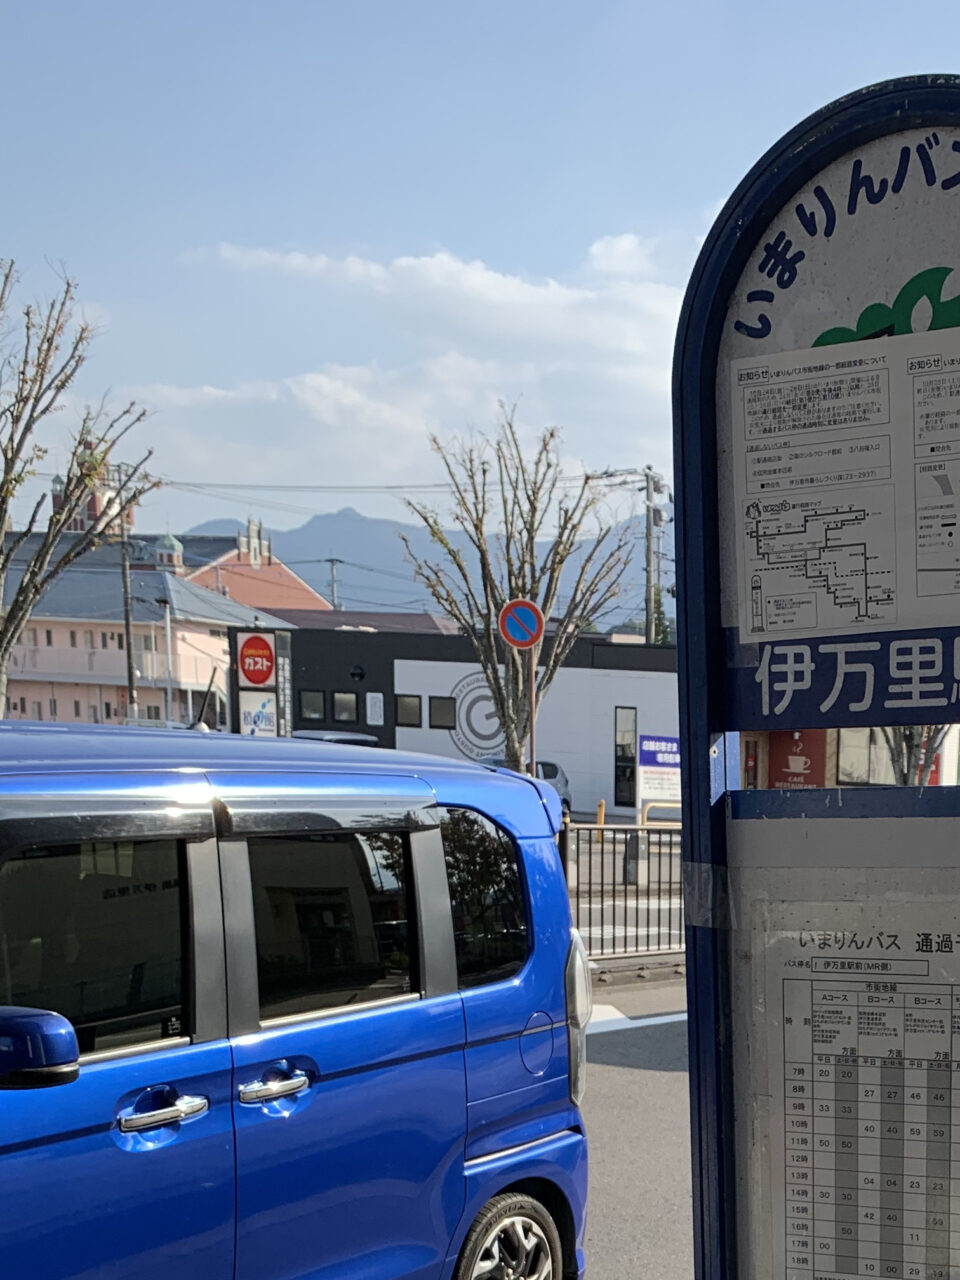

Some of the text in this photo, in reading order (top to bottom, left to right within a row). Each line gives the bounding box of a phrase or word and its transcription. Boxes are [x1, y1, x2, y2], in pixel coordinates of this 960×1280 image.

[244, 657, 272, 671] ガスト
[799, 932, 902, 951] いまりんバス
[821, 993, 849, 1002] Aコース
[867, 995, 895, 1003] Bコース
[914, 997, 943, 1005] Bコース
